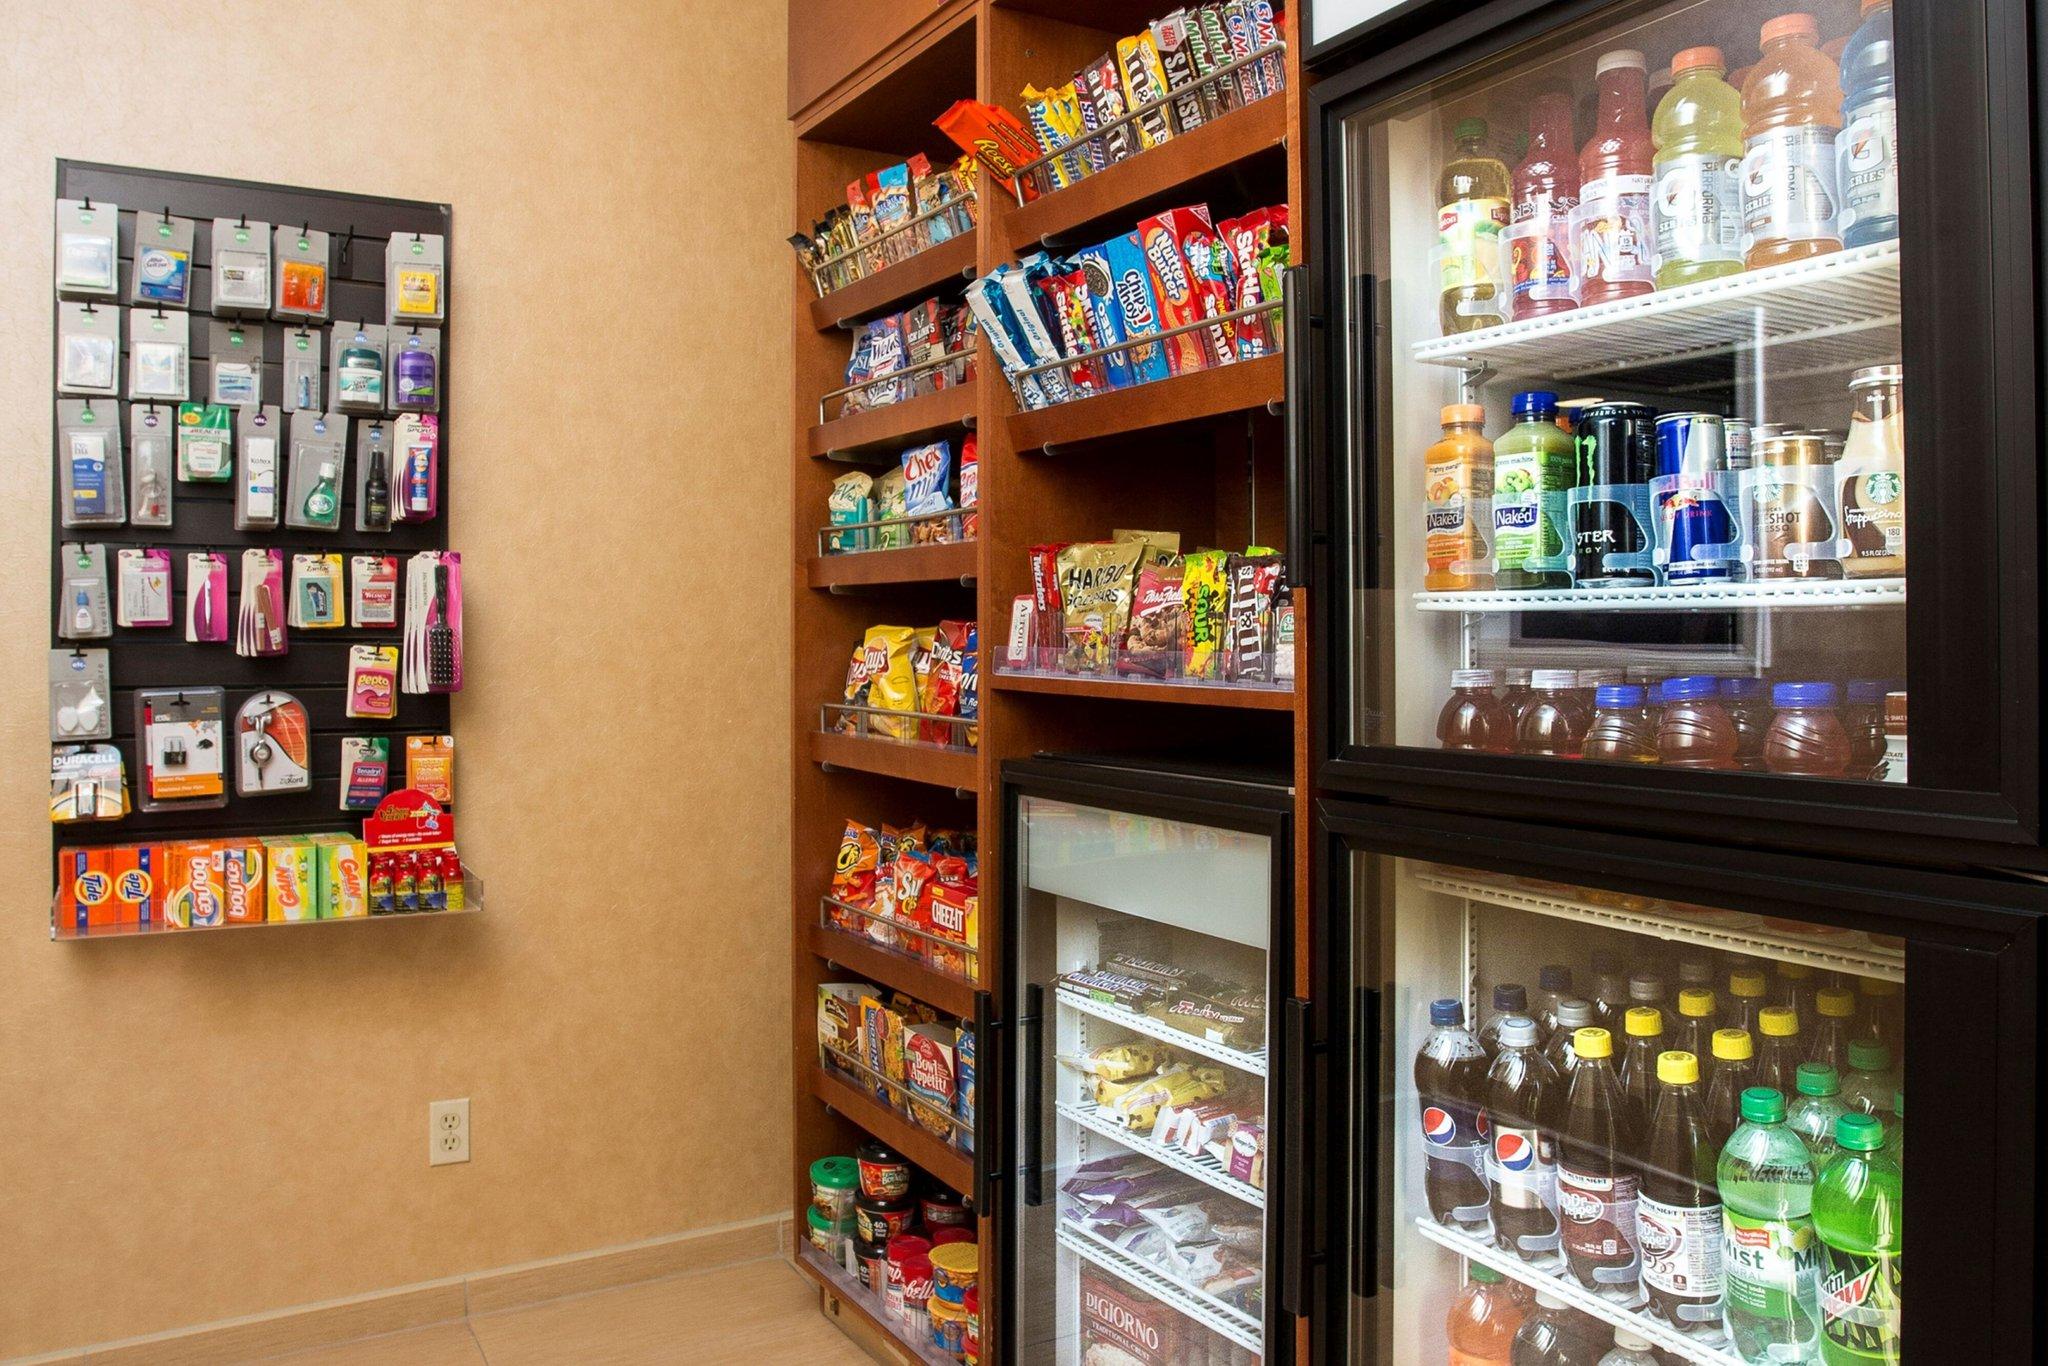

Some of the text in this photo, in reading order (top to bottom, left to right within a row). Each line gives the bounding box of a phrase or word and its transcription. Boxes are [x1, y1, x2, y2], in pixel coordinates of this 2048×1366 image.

[1147, 247, 1181, 300] Butter
[1156, 230, 1188, 290] Nutter
[1117, 282, 1150, 327] Ahoy!
[1124, 270, 1148, 315] Chips
[981, 318, 1006, 350] Original
[1016, 308, 1042, 342] Original
[1428, 511, 1460, 529] Naked
[1496, 507, 1534, 526] Naked
[1069, 563, 1127, 590] HARIBO
[1194, 583, 1210, 643] SOUR
[358, 674, 390, 687] pepto
[52, 754, 116, 767] DURACELL
[82, 874, 102, 901] Tide
[122, 872, 144, 900] Tide
[931, 899, 963, 932] CHEEZ-IT
[915, 1050, 939, 1072] Bowl
[1470, 1139, 1485, 1176] pepsi
[1586, 1177, 1608, 1185] NIGHT
[1085, 1292, 1159, 1350] DIGIORNO
